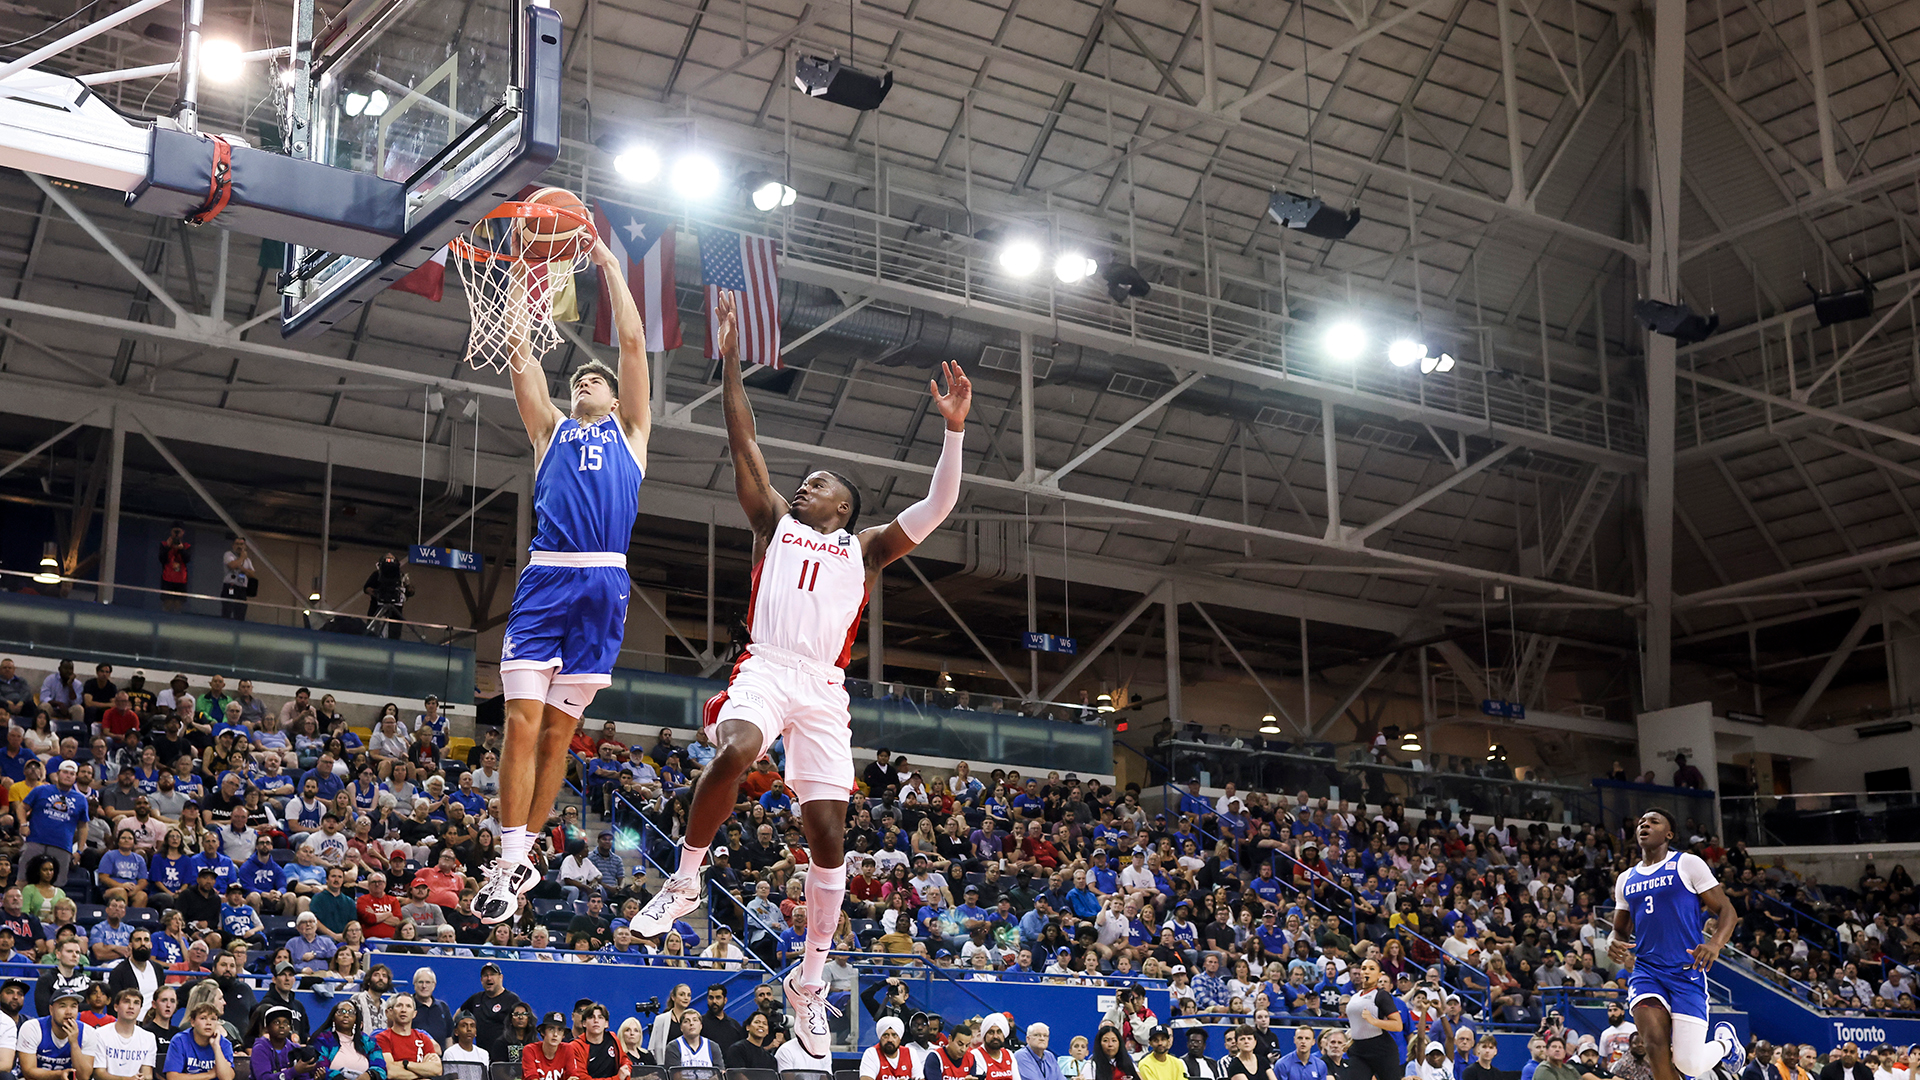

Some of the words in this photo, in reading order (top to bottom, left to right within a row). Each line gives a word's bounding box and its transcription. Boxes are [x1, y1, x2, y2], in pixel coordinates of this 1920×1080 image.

[559, 426, 618, 444] KENTUKY
[578, 445, 603, 471] 15
[419, 547, 436, 558] W4
[781, 533, 849, 559] CANADA
[458, 552, 474, 564] W5
[797, 559, 820, 592] 11
[1030, 634, 1044, 644] W5
[1059, 638, 1072, 648] W6
[212, 808, 232, 818] CANAD
[1625, 875, 1675, 896] KENTUCKY
[373, 903, 392, 912] CAN
[1644, 895, 1654, 914] 3
[412, 912, 434, 921] CAN
[5, 919, 33, 938] USA
[1833, 1022, 1886, 1042] Toronto
[415, 1039, 424, 1063] CAN
